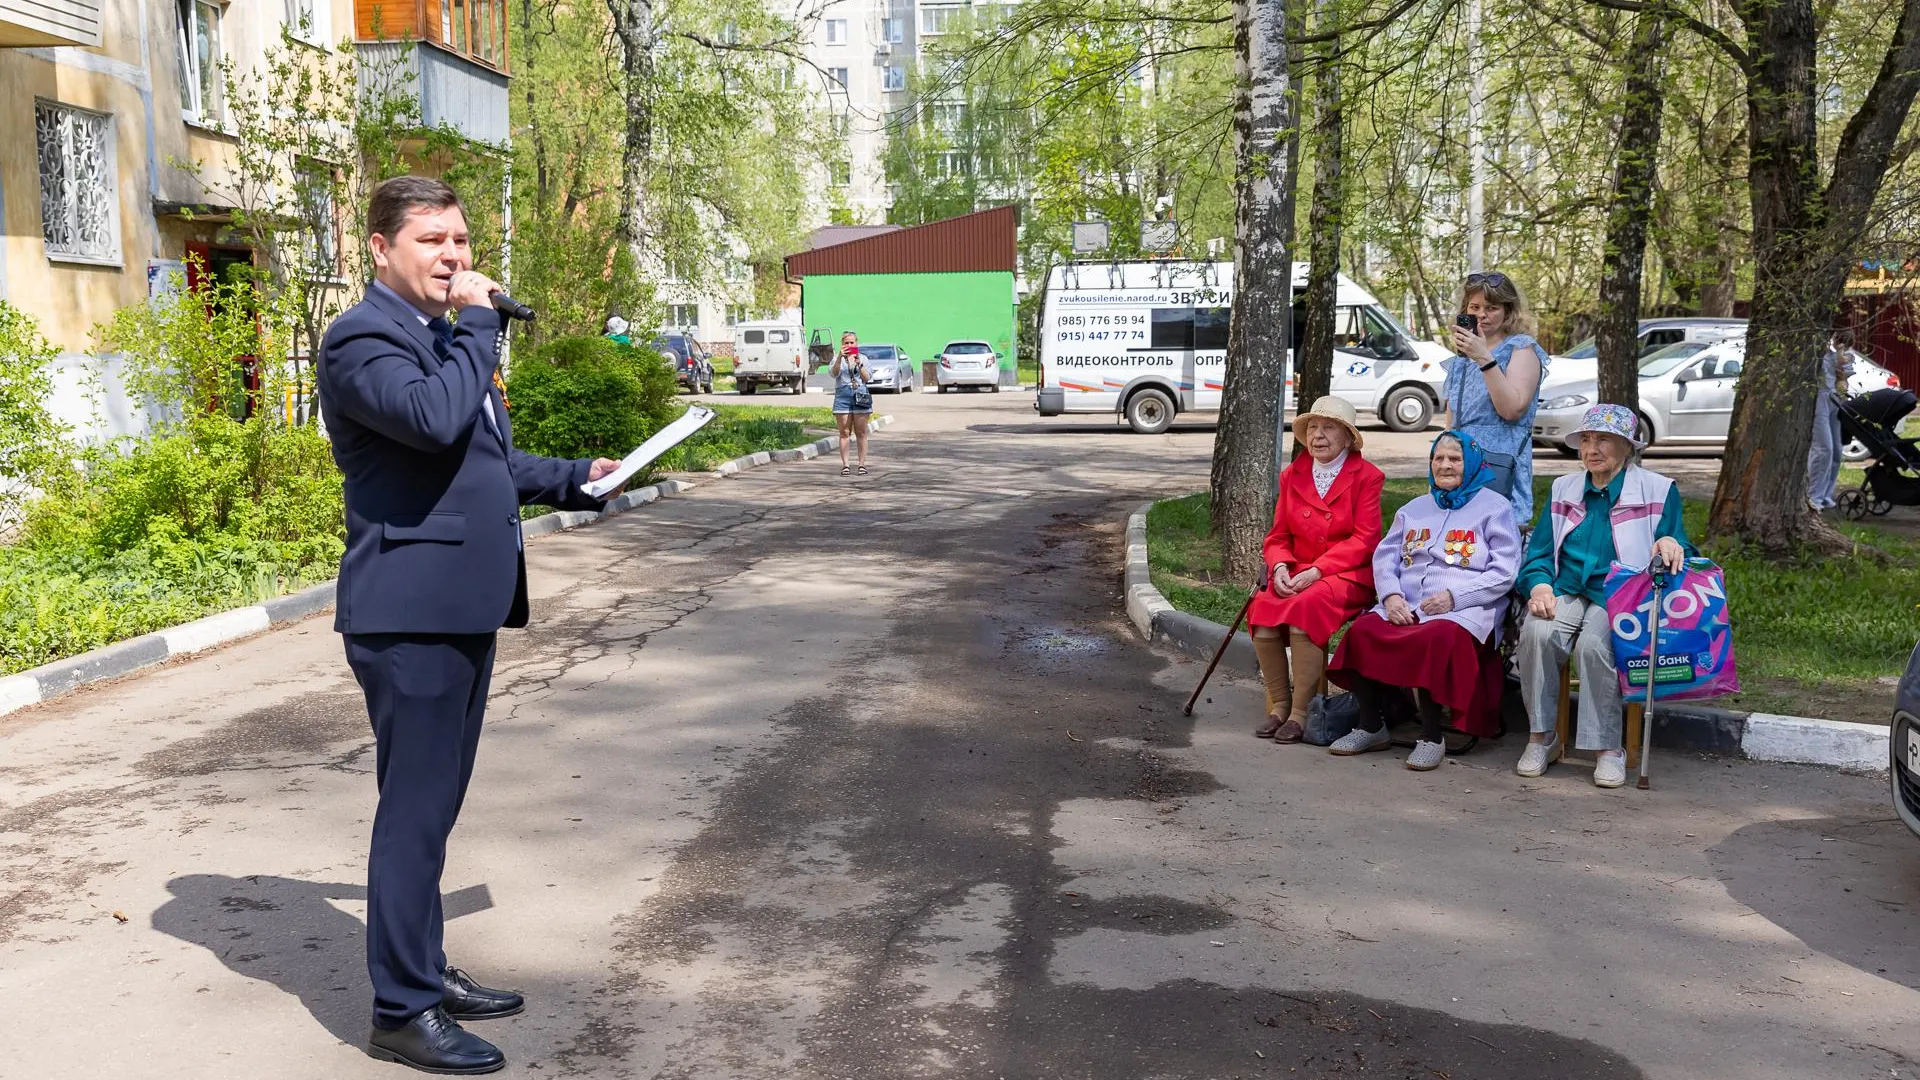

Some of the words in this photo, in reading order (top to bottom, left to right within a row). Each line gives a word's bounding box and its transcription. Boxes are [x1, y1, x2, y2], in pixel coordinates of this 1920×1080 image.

[1058, 294, 1168, 304] zvukousilenie.narod.ru
[1057, 315, 1086, 327] (985)
[1090, 315, 1110, 325] 776
[1114, 315, 1128, 325] 59
[1131, 315, 1145, 325] 94
[1057, 331, 1085, 342] (915)
[1089, 331, 1110, 340] 447
[1113, 330, 1127, 340] 77
[1131, 330, 1145, 340] 74
[1056, 355, 1174, 368] ВИДЕОКОНТРОЛЬ
[1612, 576, 1726, 641] OZON
[1627, 659, 1651, 668] ozo
[1657, 655, 1691, 666] банк
